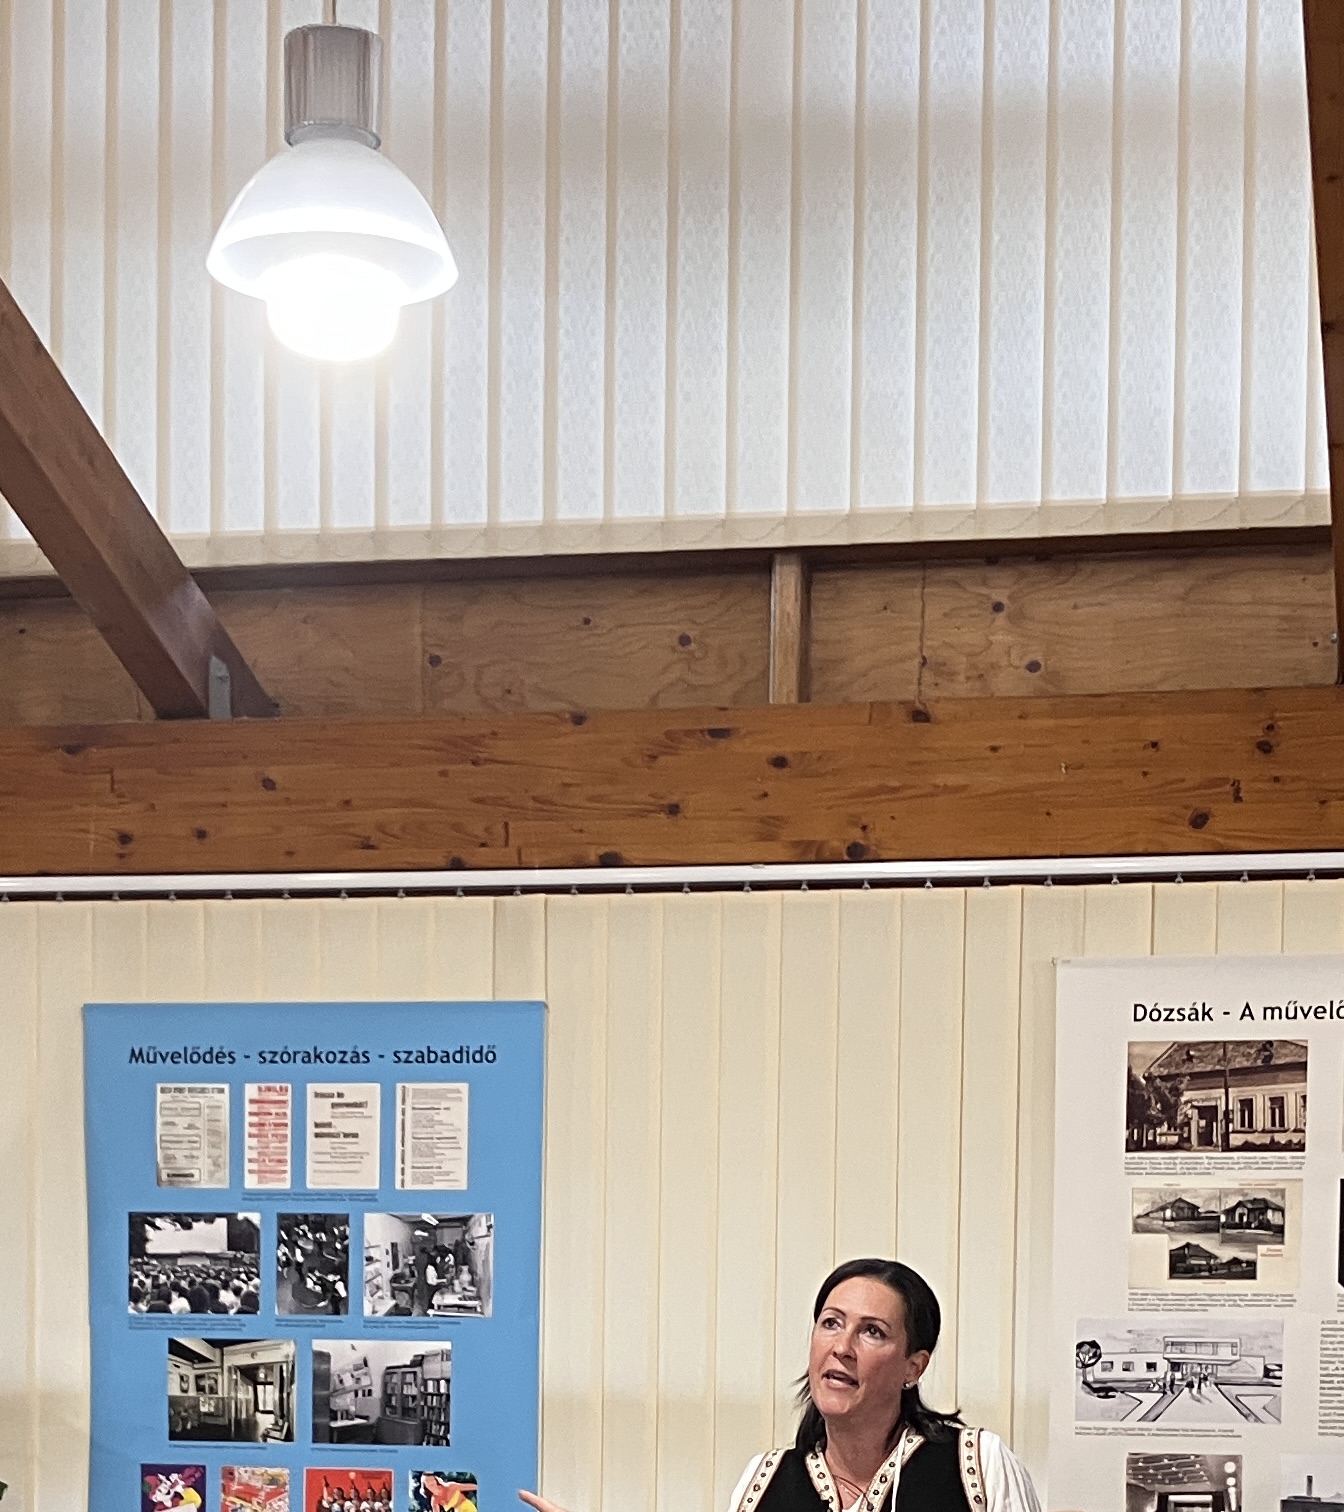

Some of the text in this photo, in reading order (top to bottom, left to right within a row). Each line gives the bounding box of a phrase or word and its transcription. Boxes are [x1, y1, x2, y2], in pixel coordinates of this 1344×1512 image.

[1132, 1001, 1214, 1022] Dózsák
[1239, 1005, 1255, 1021] A
[127, 1045, 237, 1065] Művelődés
[258, 1045, 371, 1065] szórakozás
[392, 1045, 498, 1065] szabadidő
